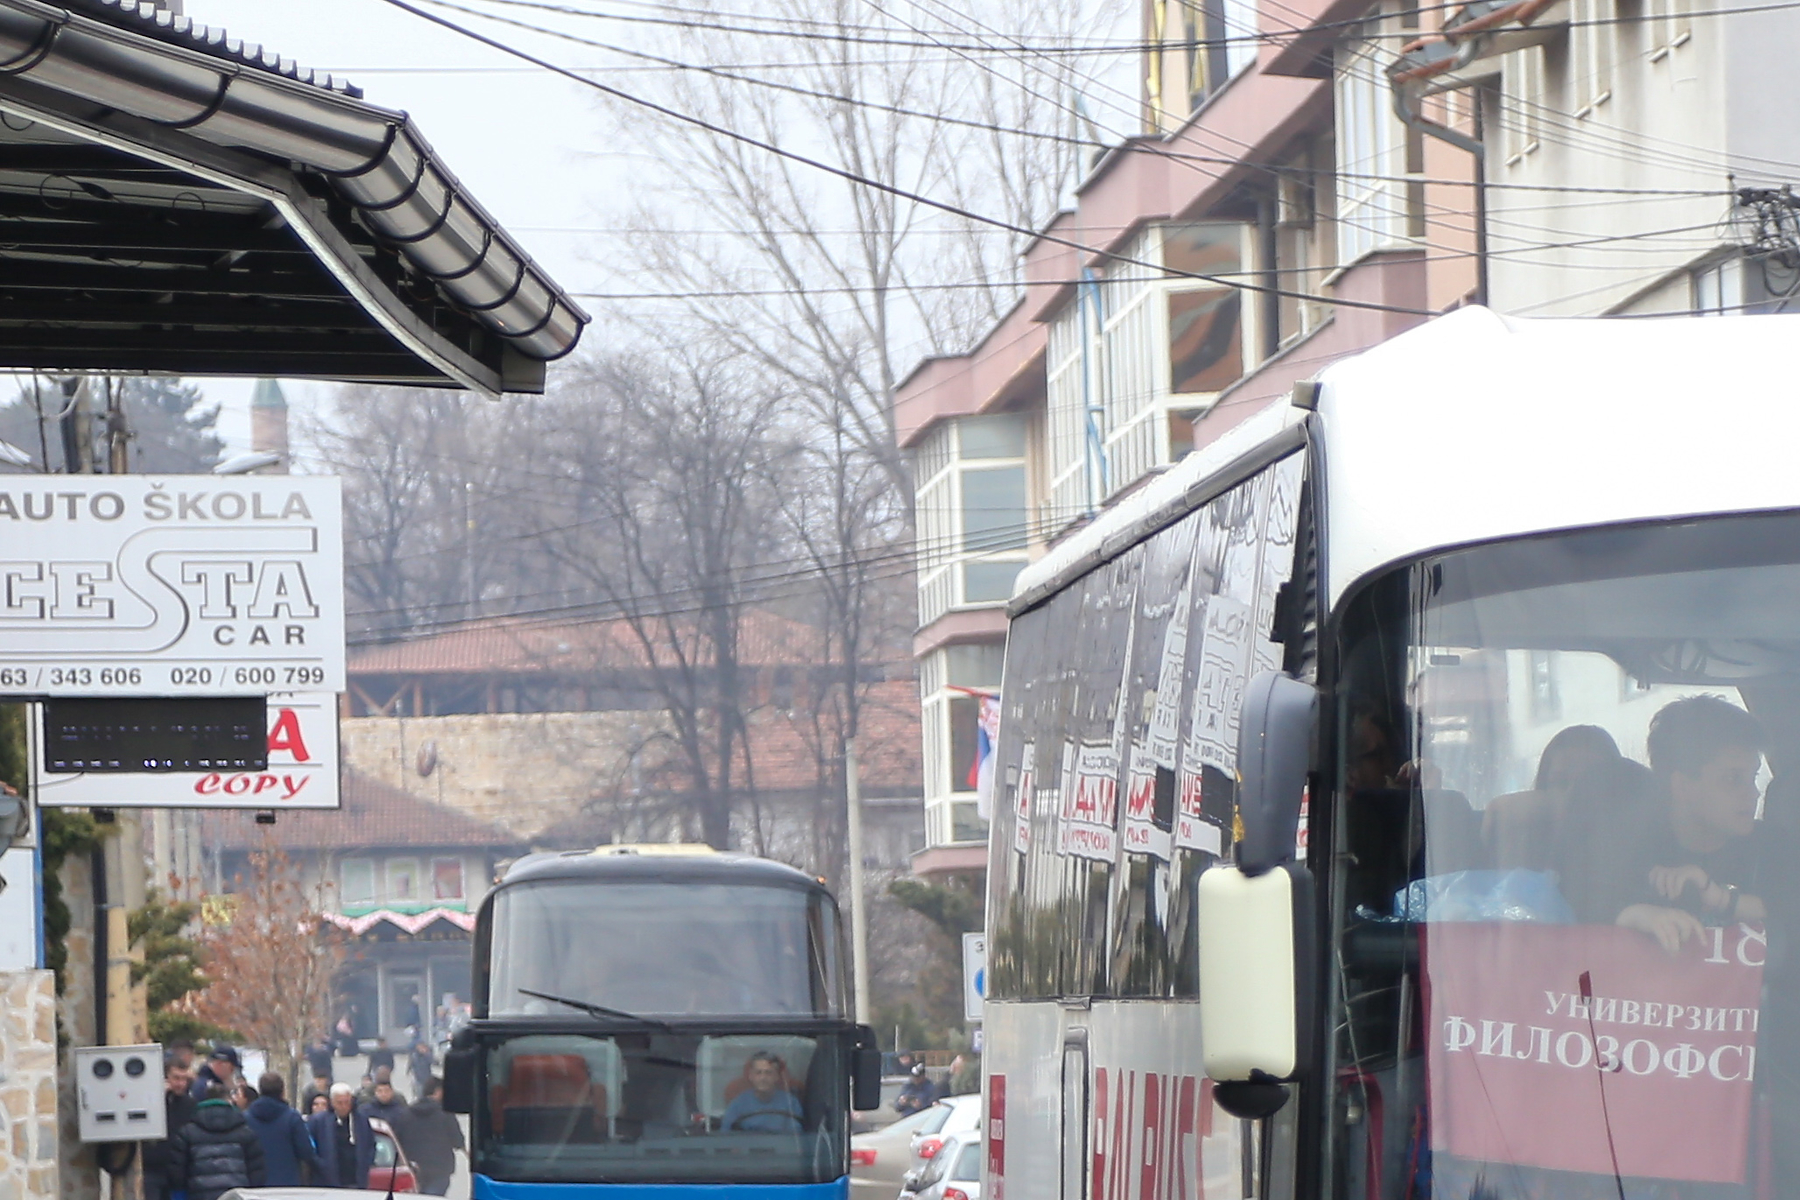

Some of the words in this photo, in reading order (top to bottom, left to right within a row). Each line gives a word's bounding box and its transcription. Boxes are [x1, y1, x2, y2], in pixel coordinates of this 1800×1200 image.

[0, 492, 125, 521] AUTO
[143, 482, 313, 521] ŠKOLA
[213, 624, 306, 646] CAR
[51, 668, 92, 686] 343
[100, 668, 141, 686] 606
[170, 667, 212, 685] 020
[235, 667, 275, 685] 600
[284, 667, 324, 685] 799
[194, 772, 311, 800] COPY
